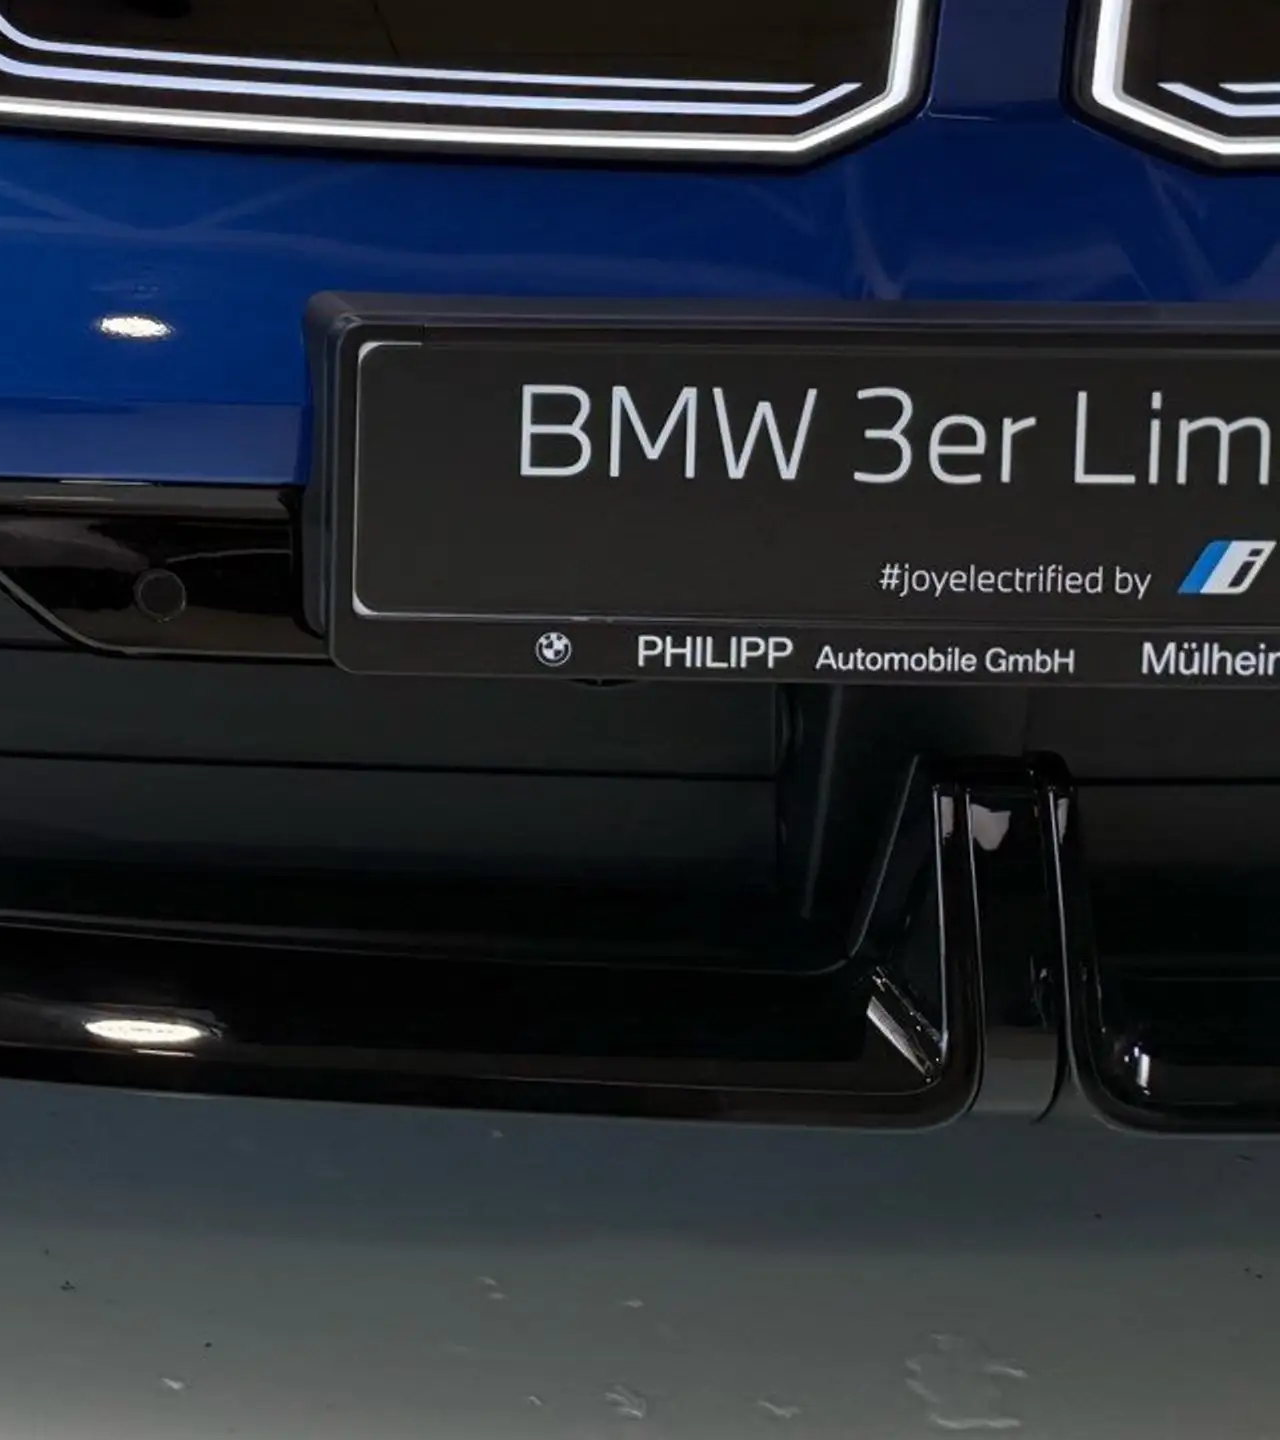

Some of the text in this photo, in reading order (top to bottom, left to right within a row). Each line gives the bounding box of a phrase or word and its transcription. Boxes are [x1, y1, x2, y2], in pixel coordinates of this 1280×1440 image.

[520, 383, 1272, 486] BMW 3er Lim
[878, 563, 1104, 598] #joyelectrified
[1114, 564, 1152, 600] by
[637, 634, 795, 669] PHILIPP
[815, 645, 978, 673] Automobile
[985, 646, 1075, 675] GmbH
